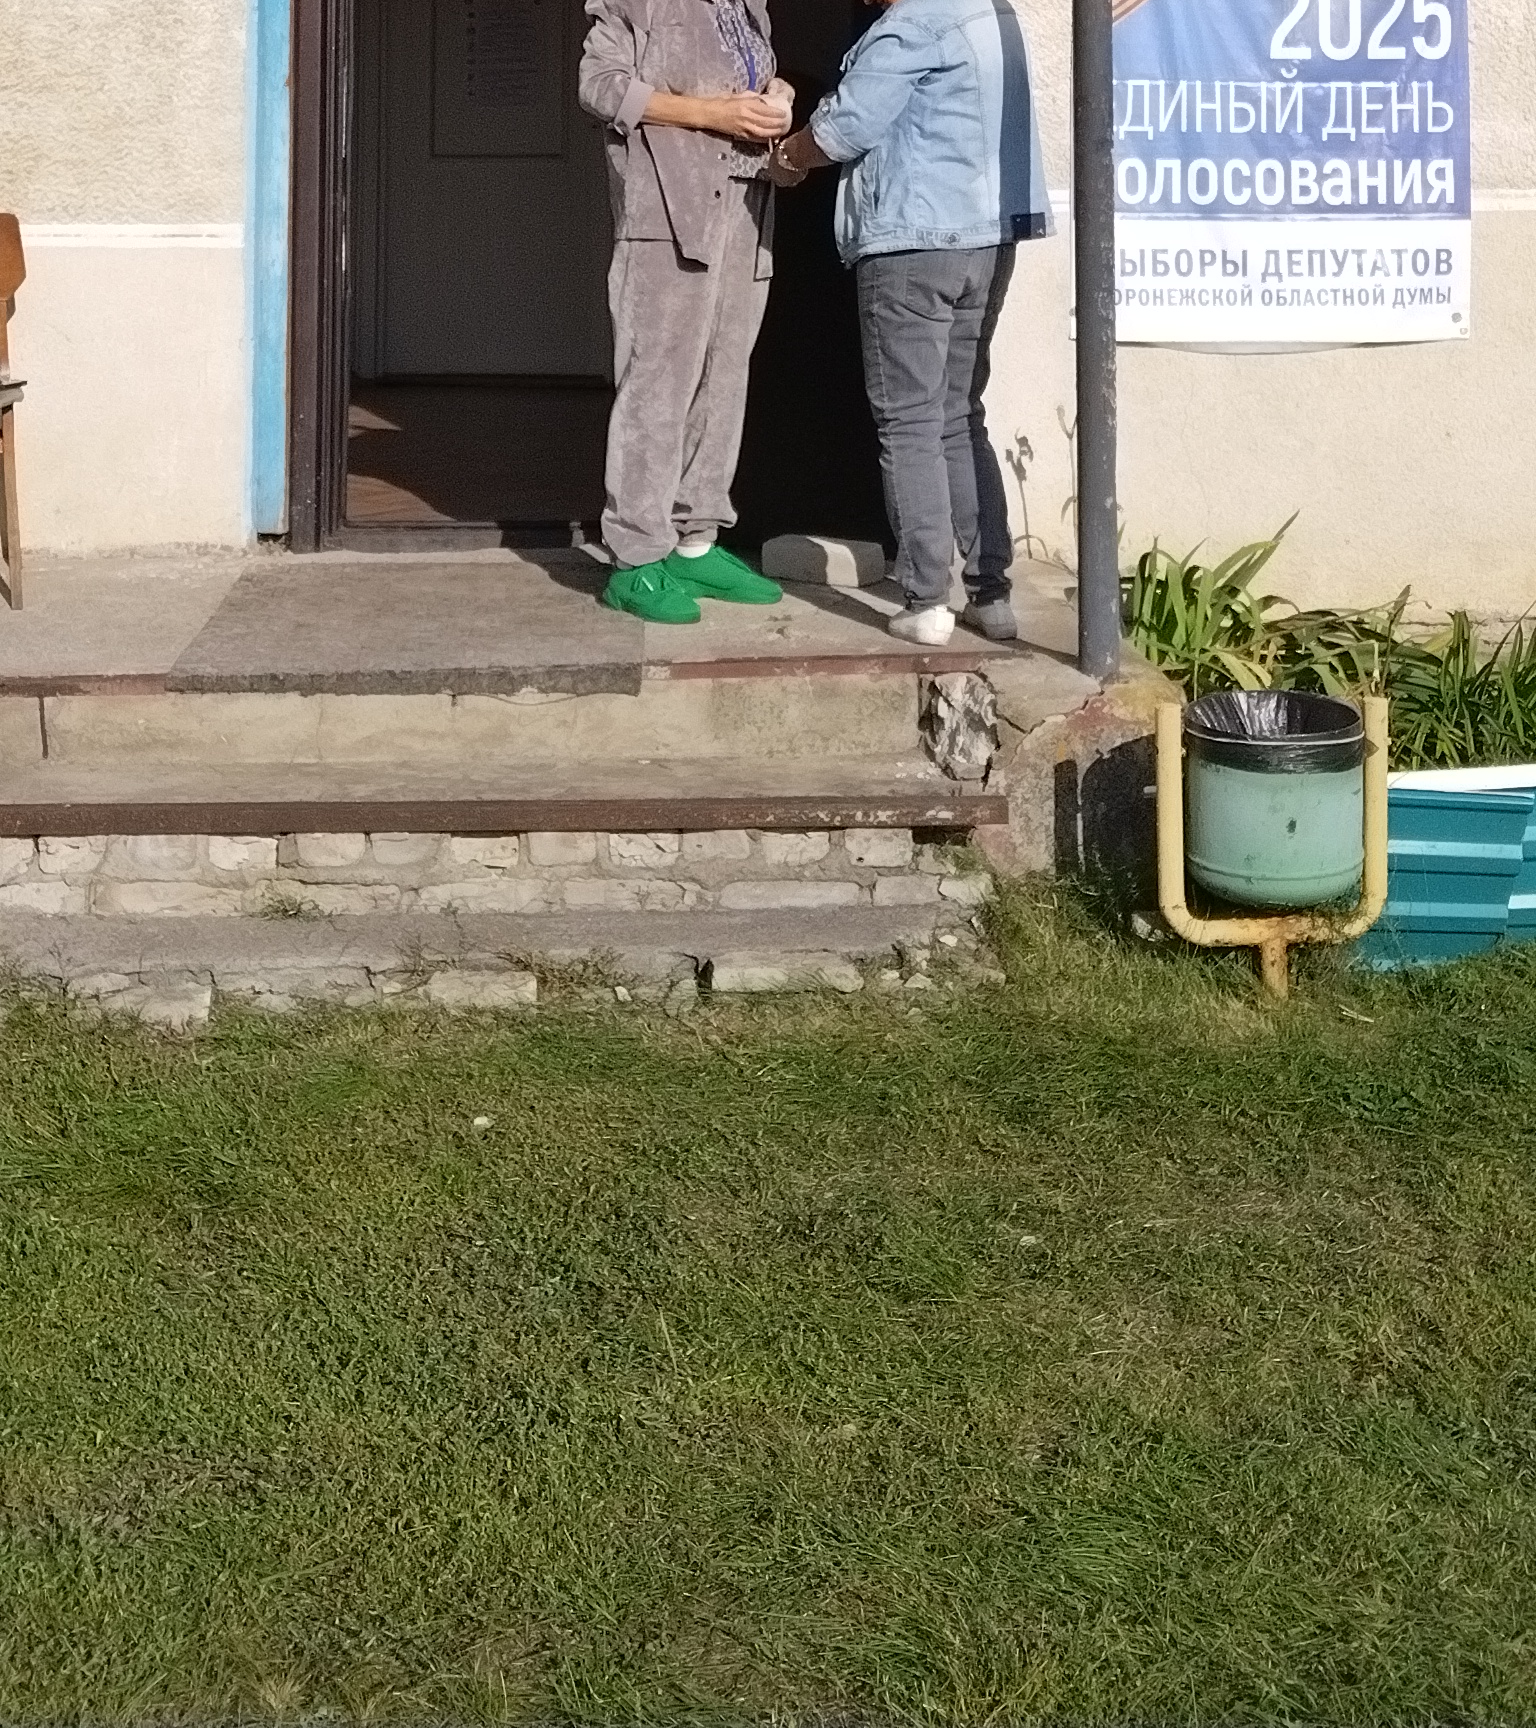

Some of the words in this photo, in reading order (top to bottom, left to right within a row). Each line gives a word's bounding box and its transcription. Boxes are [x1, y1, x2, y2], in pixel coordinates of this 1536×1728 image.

[1112, 64, 1304, 141] ДИНЫЙ
[1321, 80, 1454, 142] ДЕНЬ
[1116, 158, 1456, 206] олосования
[1119, 248, 1249, 278] ЫБОРЫ
[1261, 248, 1454, 283] ДЕПУТАТОВ
[1113, 284, 1254, 307] ОРОНЕЖСКОЙ
[1261, 285, 1385, 307] ОБЛАСТНОЙ
[1392, 286, 1452, 309] ДУМЫ
